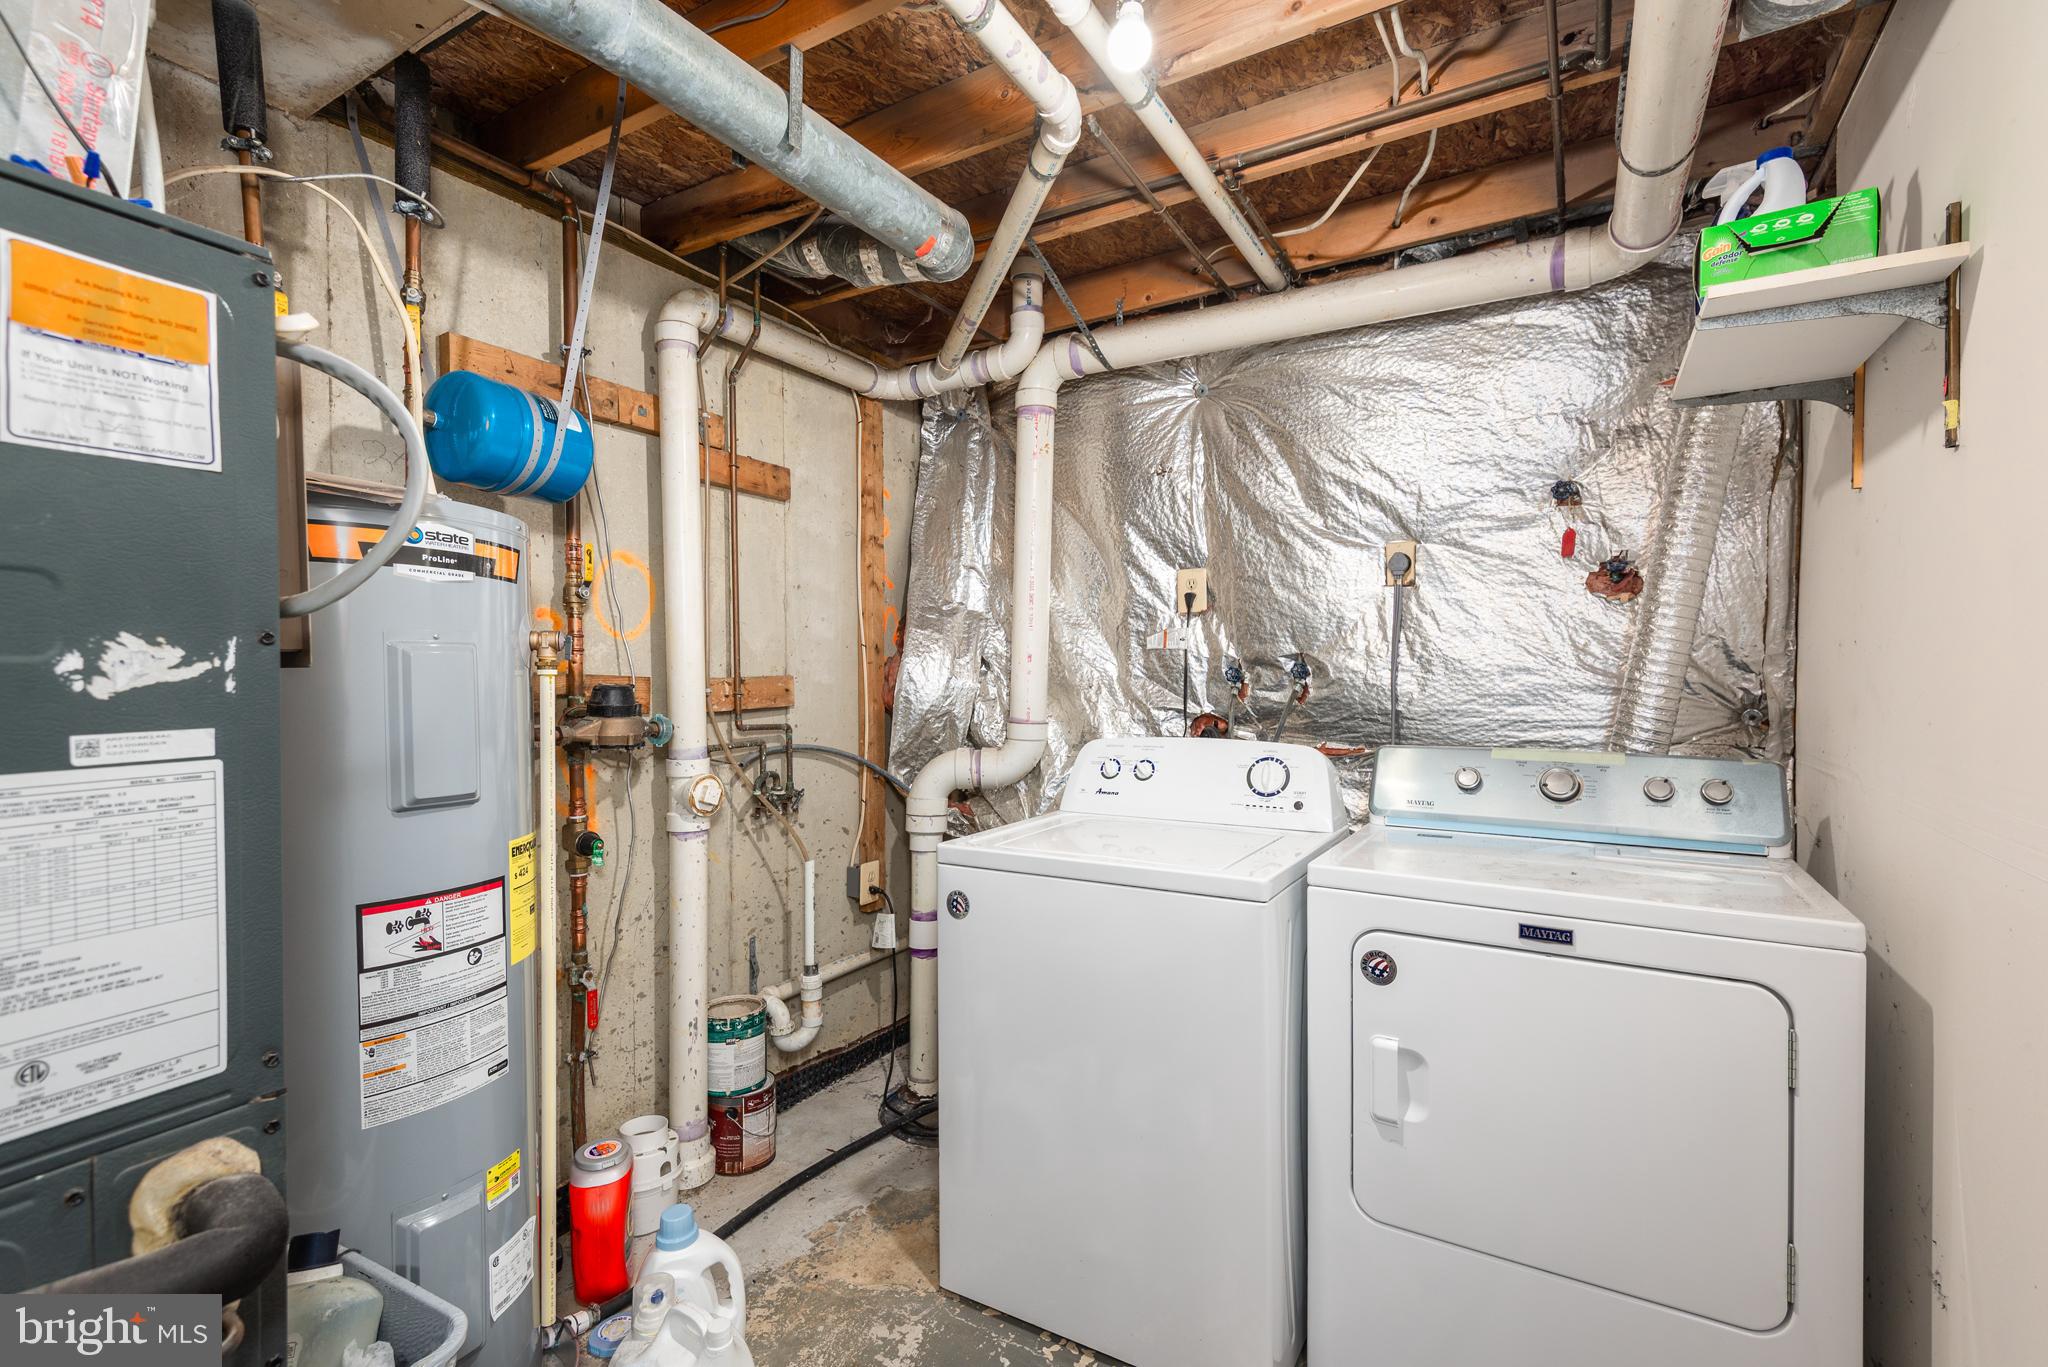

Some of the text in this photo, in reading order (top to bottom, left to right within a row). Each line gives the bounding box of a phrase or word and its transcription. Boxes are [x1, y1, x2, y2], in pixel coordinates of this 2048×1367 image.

[1702, 243, 1731, 261] Gain
[21, 350, 189, 392] If Your Unit is NOT Working
[425, 531, 469, 546] state
[409, 568, 446, 576] COMMERCIAL
[1095, 788, 1119, 796] Amana
[434, 893, 462, 903] DANGER
[1522, 926, 1572, 942] MAYTAG
[1362, 951, 1388, 970] AMERICA
